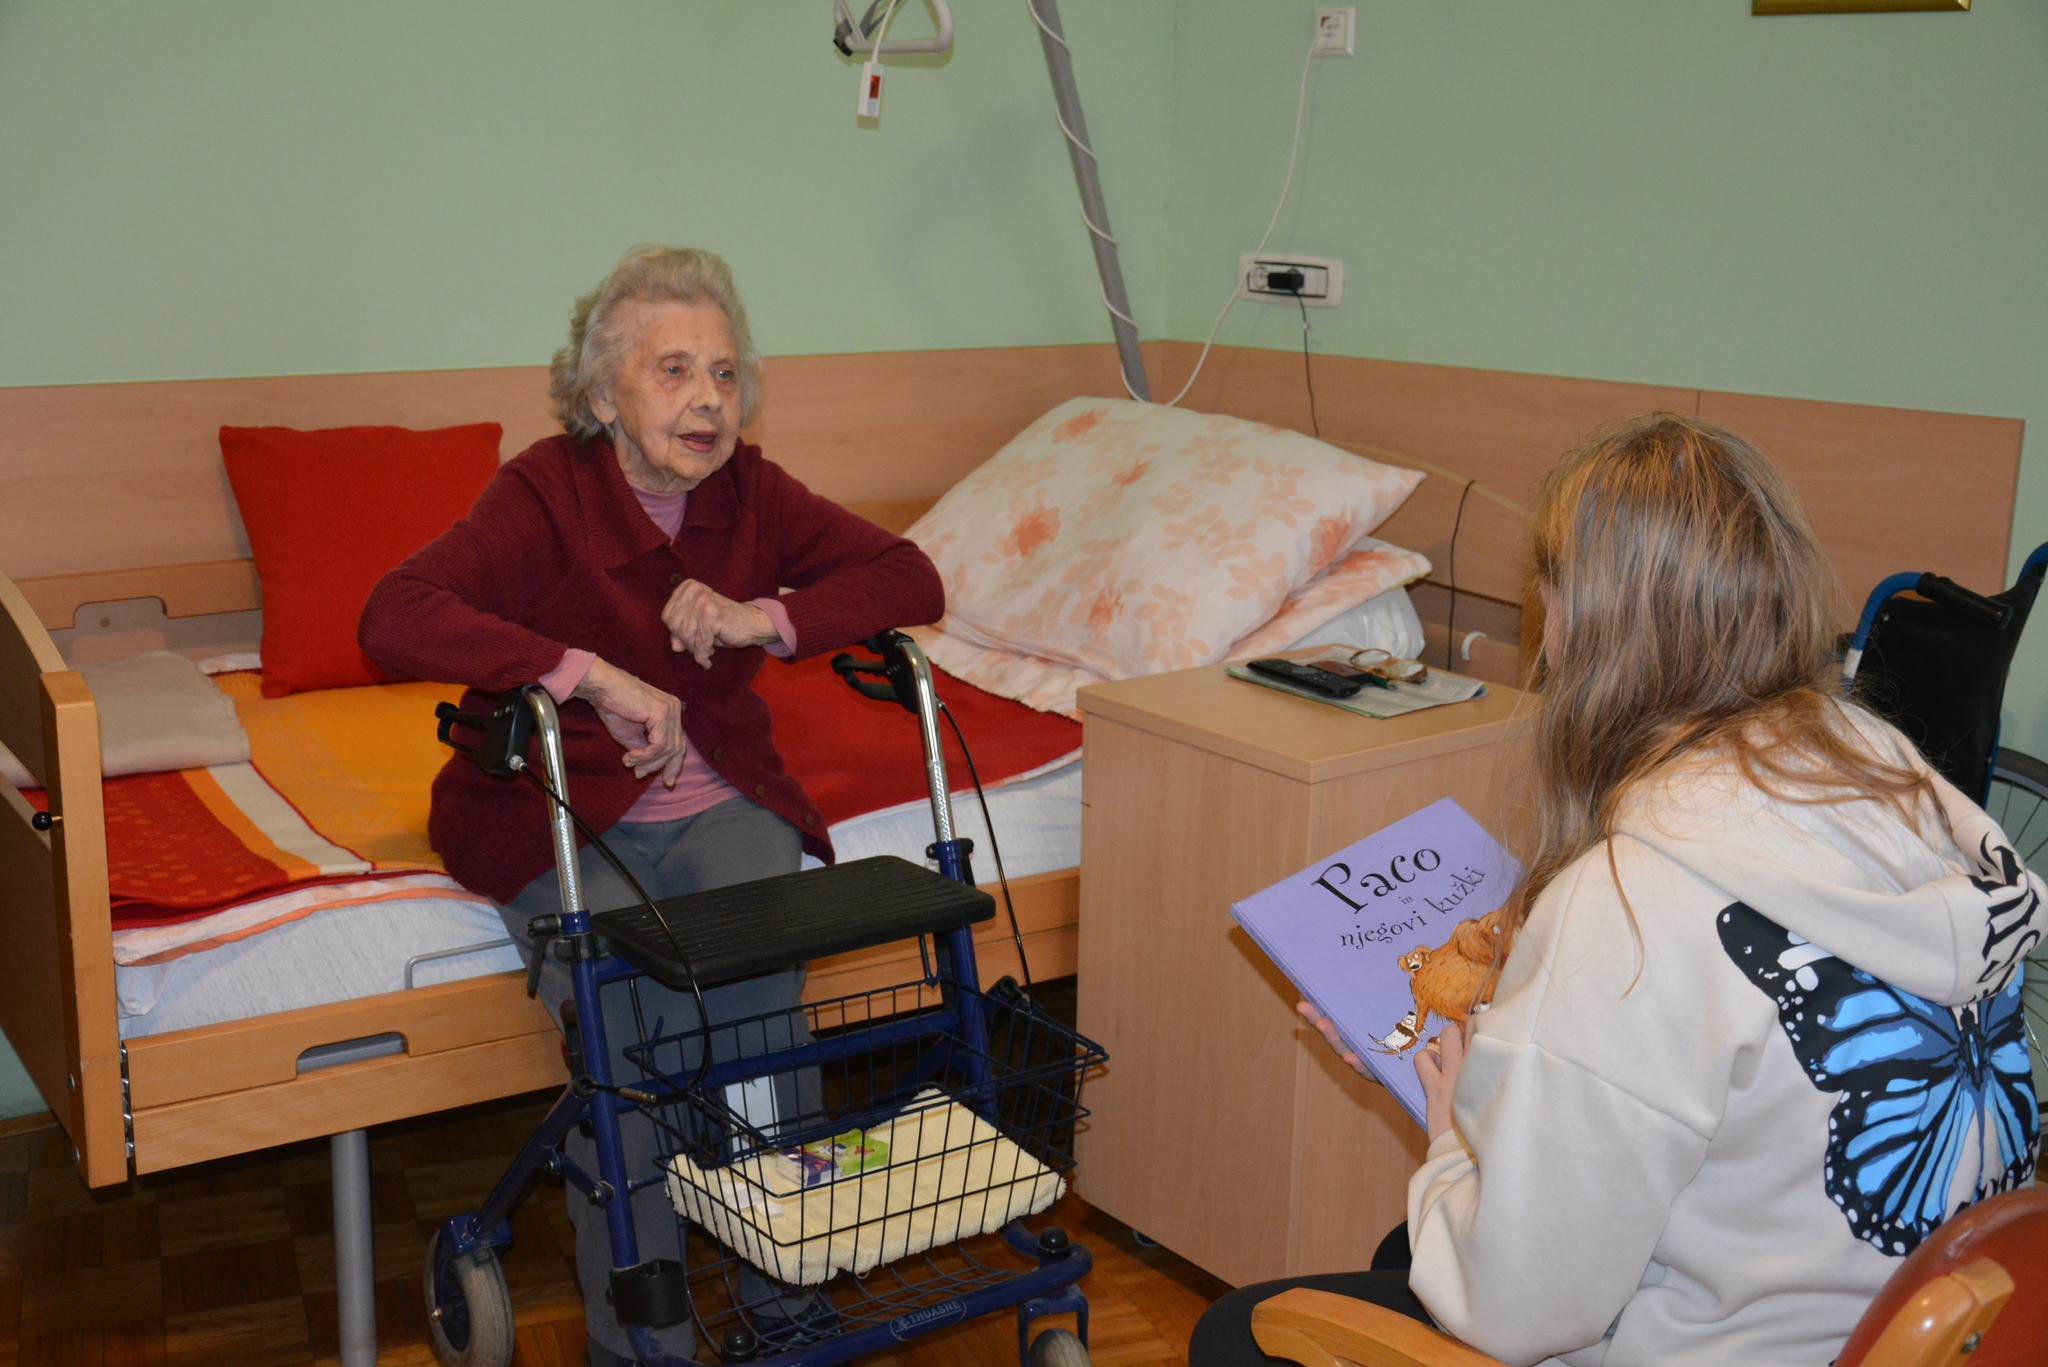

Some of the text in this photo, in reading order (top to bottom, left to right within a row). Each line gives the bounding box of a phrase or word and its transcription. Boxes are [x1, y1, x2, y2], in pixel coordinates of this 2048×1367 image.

[1311, 848, 1441, 914] Paco
[1398, 895, 1413, 905] in
[1340, 866, 1486, 949] njegovi kužki
[909, 1300, 960, 1324] THUASNE
